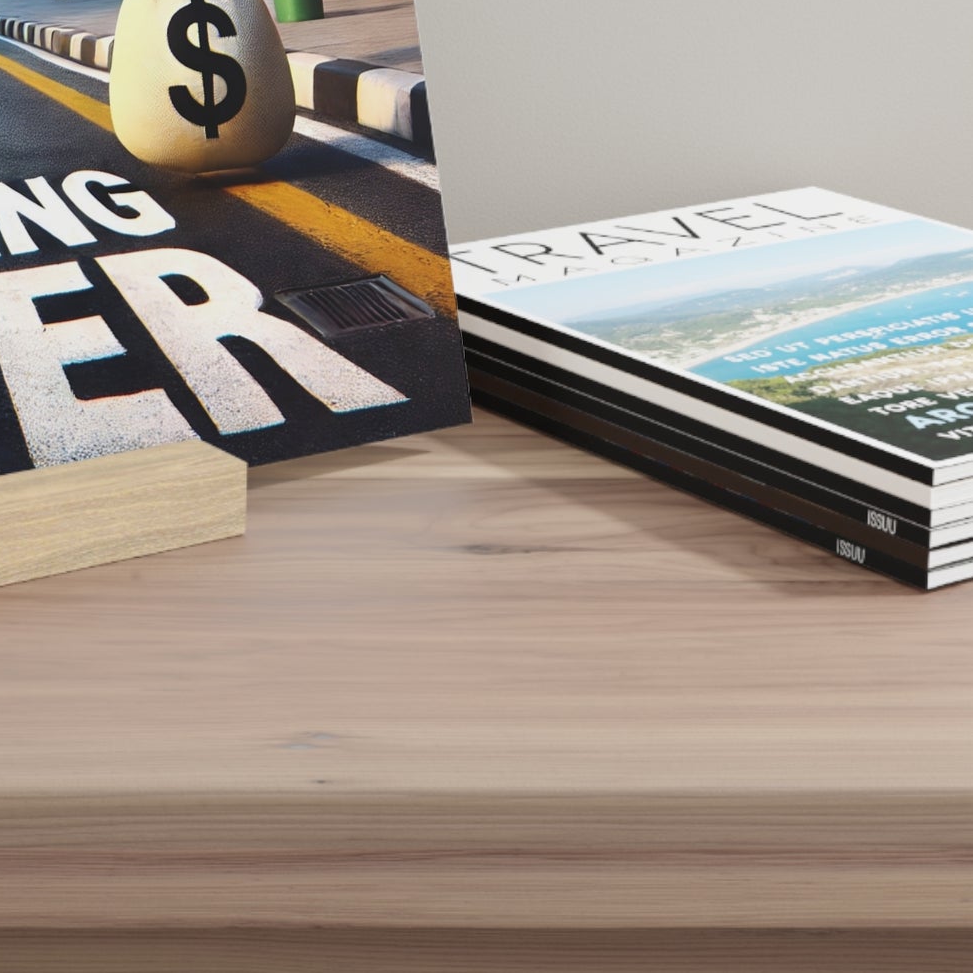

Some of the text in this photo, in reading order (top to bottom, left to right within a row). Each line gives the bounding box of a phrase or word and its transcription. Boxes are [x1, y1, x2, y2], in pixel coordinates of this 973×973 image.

[449, 202, 844, 274] TRAVEL
[776, 340, 810, 354] UT
[808, 341, 888, 363] NATUS
[888, 326, 967, 345] ERROR
[867, 397, 938, 416] TORE
[867, 508, 897, 535] ISSUU
[836, 538, 866, 564] ISSUU
